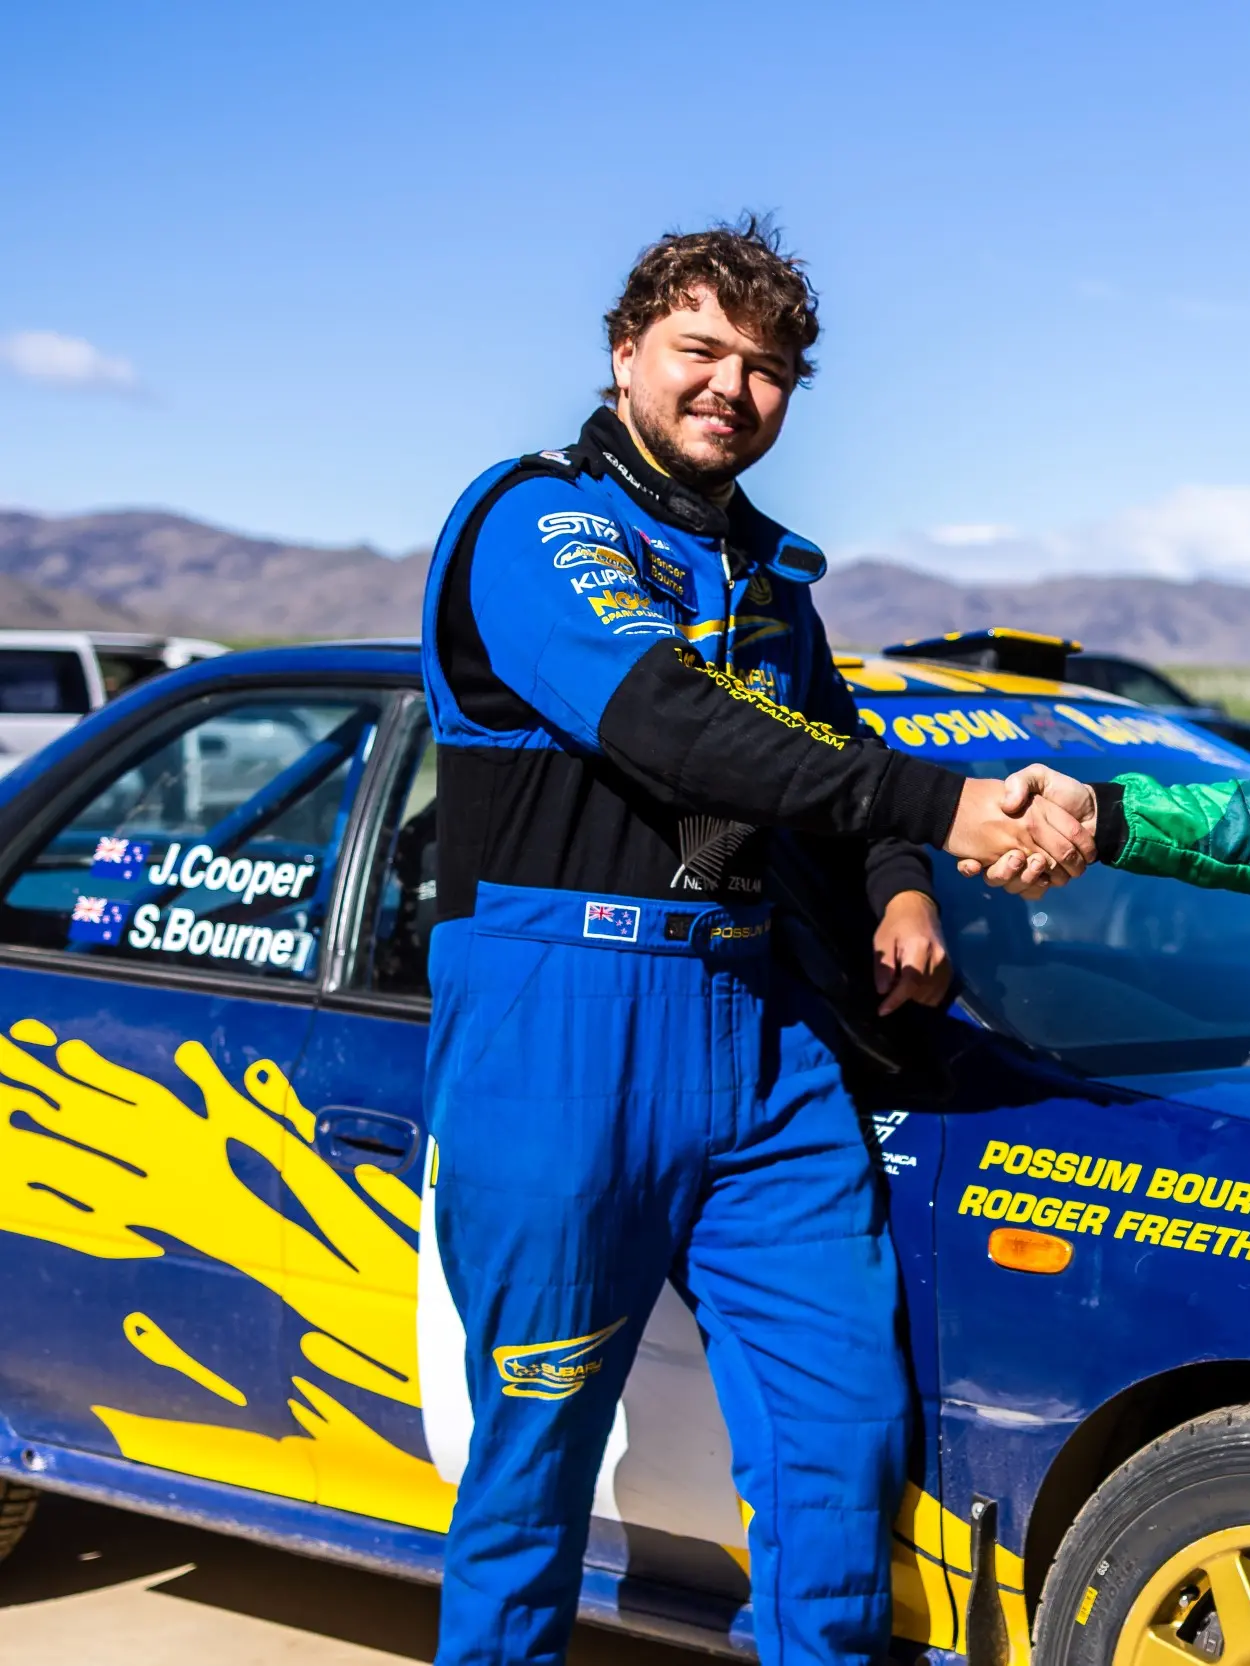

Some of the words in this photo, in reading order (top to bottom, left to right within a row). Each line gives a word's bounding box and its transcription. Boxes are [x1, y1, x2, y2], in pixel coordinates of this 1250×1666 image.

[650, 553, 686, 579] pencer
[587, 589, 651, 617] NGK
[601, 610, 635, 625] SPARK
[804, 724, 845, 751] TEAM
[148, 843, 316, 904] J.Cooper
[727, 875, 763, 894] ZEALA
[978, 1140, 1143, 1194] POSSUM
[957, 1184, 1109, 1236] RODGER
[541, 1357, 603, 1378] SUBARU
